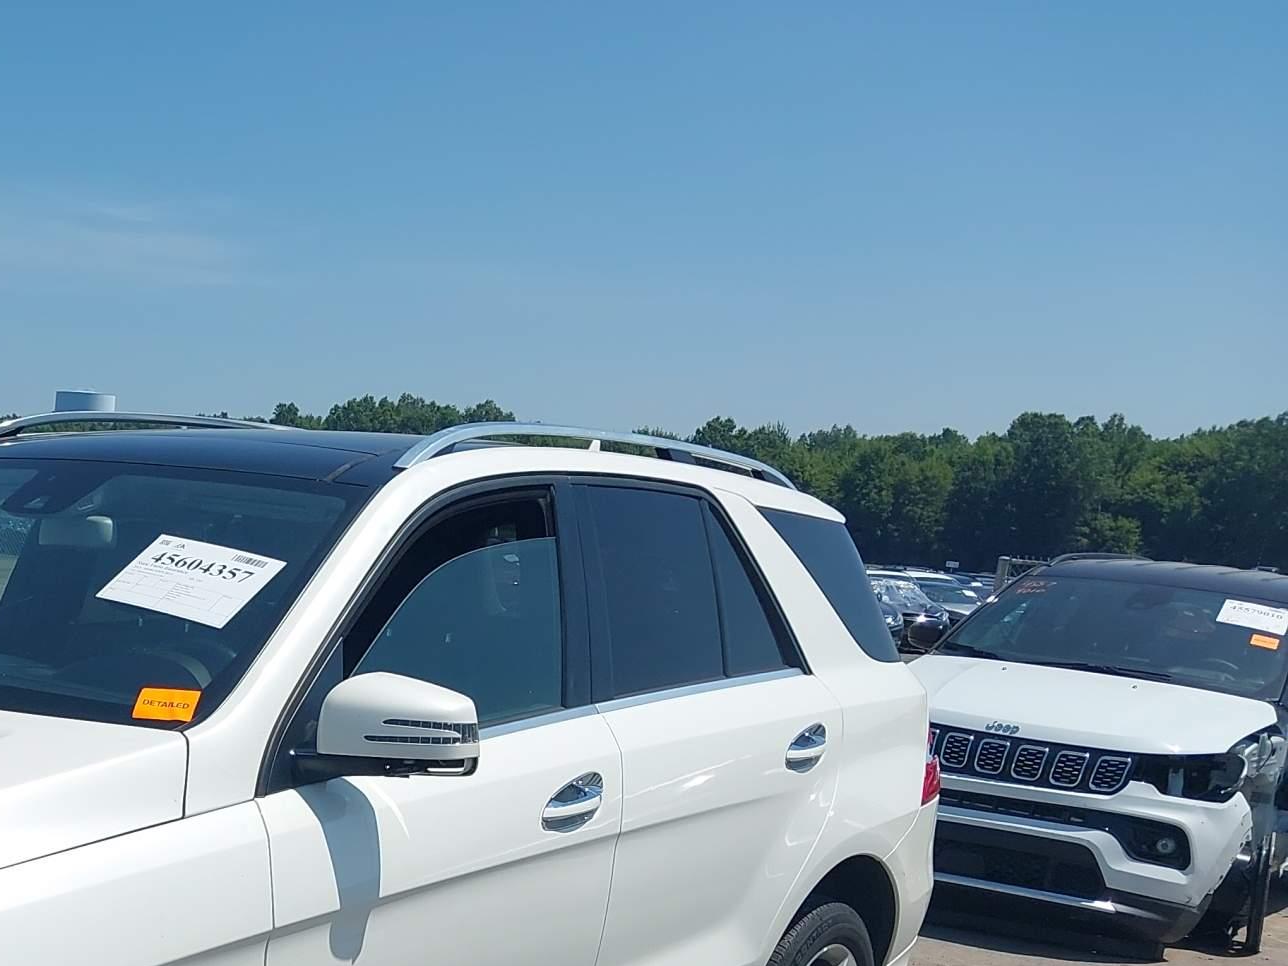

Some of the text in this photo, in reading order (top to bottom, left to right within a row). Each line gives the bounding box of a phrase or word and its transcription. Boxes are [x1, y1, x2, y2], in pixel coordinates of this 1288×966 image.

[151, 552, 255, 583] 45604357
[142, 699, 190, 709] DETAILED
[985, 720, 1020, 734] Jeep
